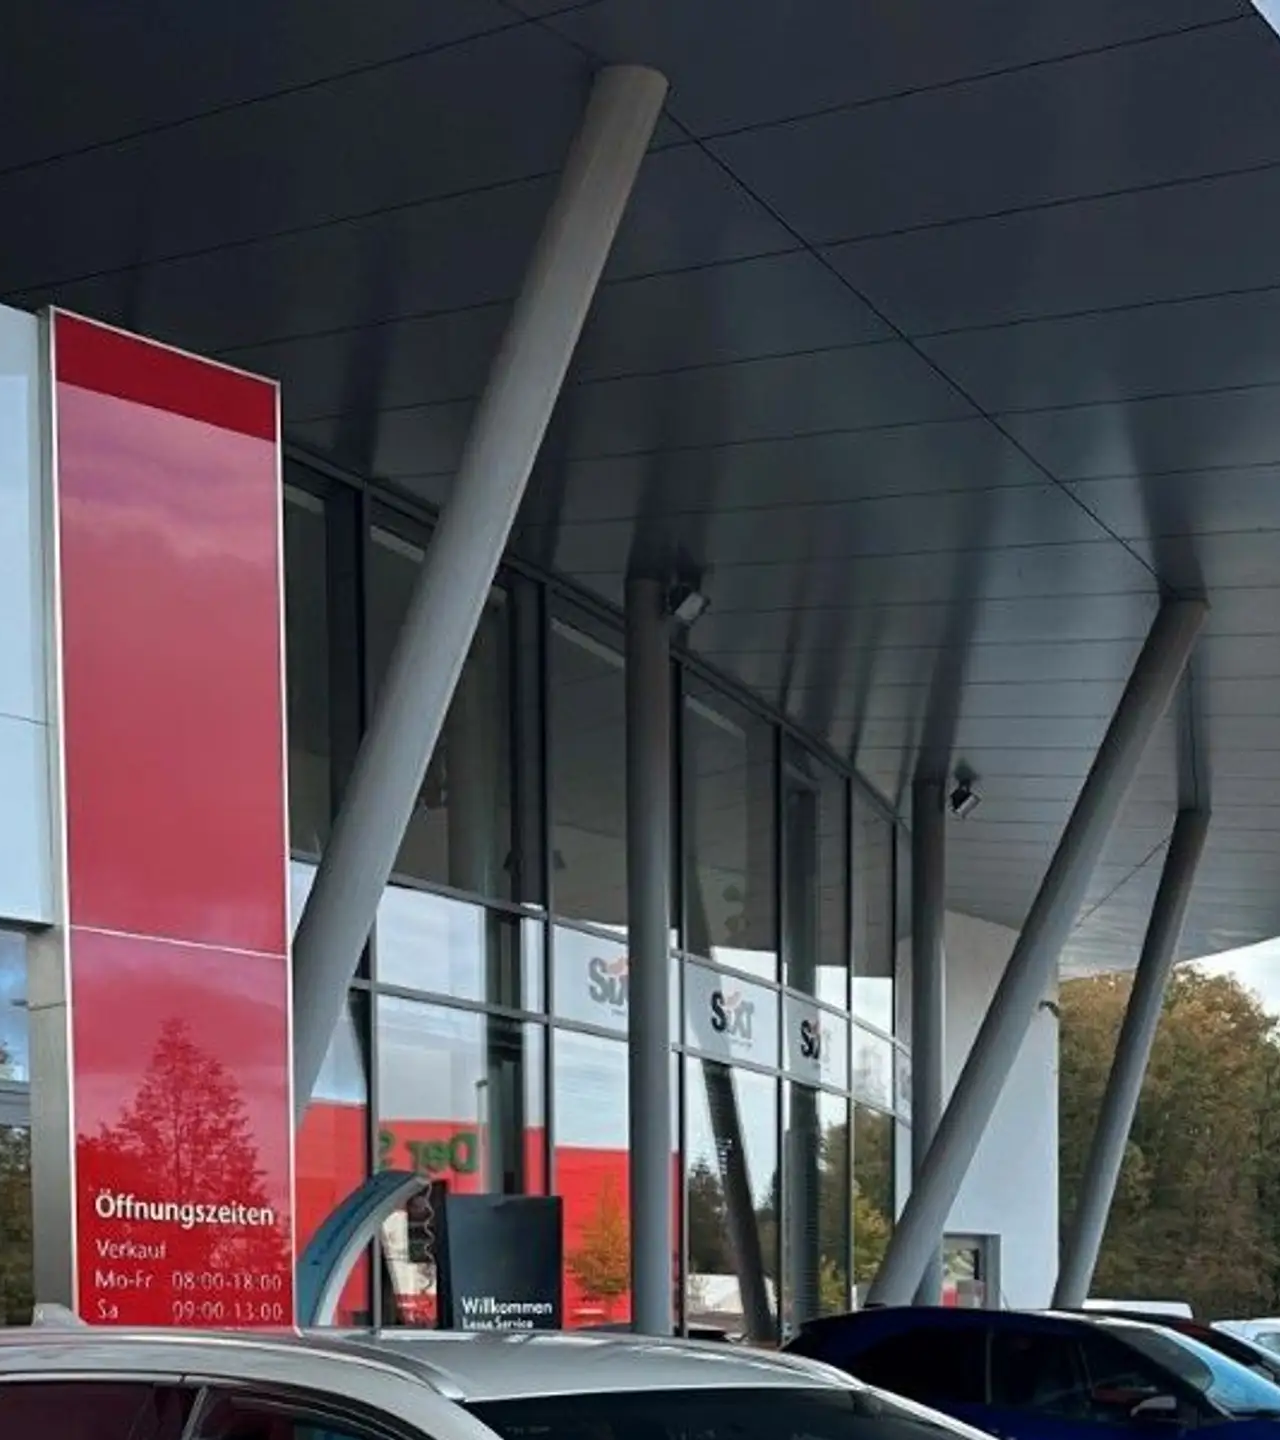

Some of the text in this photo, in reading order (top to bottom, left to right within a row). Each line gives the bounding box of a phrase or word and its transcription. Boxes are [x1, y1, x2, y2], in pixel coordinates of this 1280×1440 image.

[95, 1188, 275, 1229] Öffnungszeiten
[95, 1239, 167, 1260] Verkauf
[95, 1269, 154, 1290] Mo-Fr
[97, 1299, 119, 1319] Sa
[461, 1296, 553, 1315] Willkommen
